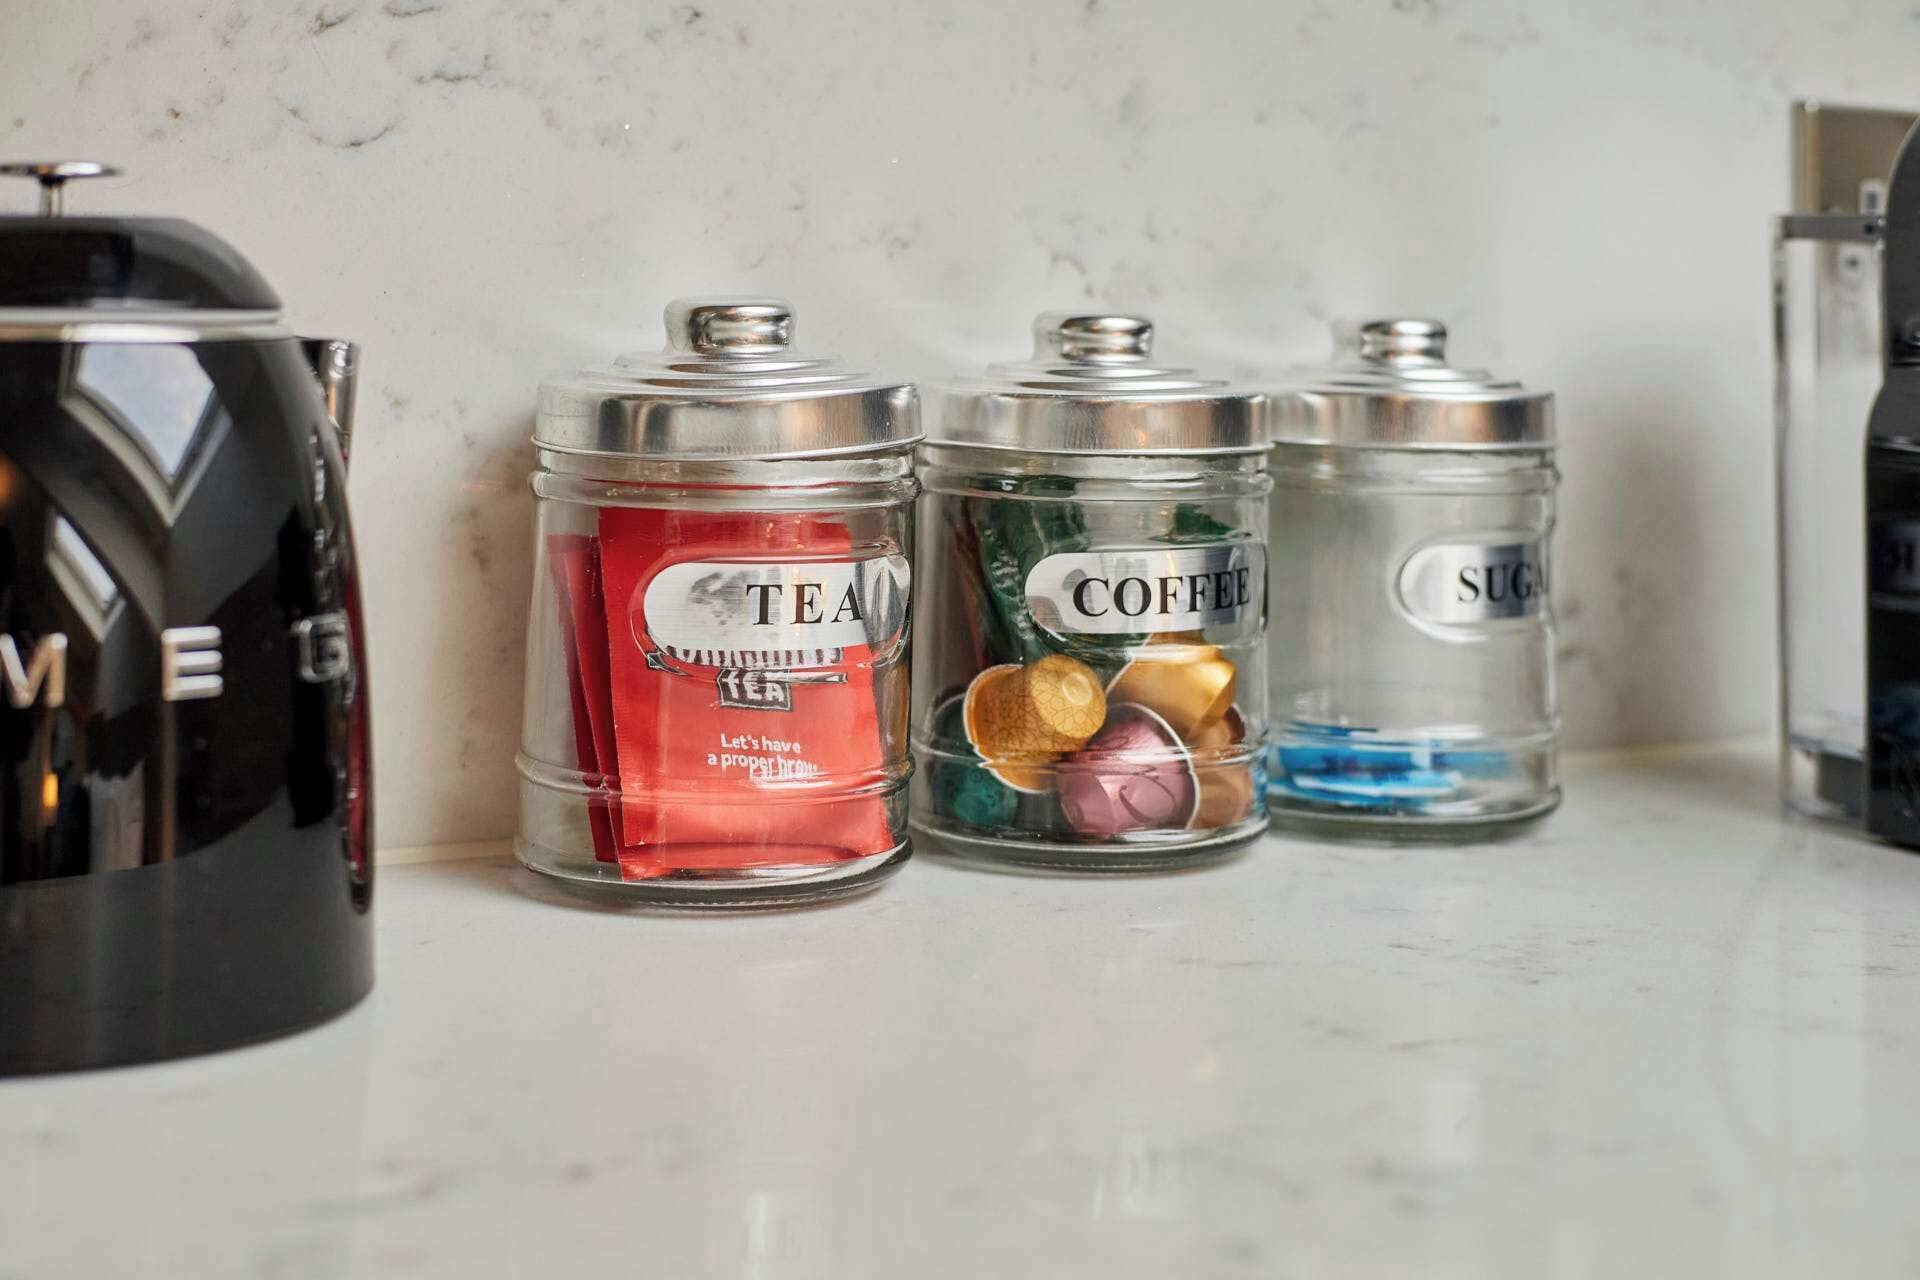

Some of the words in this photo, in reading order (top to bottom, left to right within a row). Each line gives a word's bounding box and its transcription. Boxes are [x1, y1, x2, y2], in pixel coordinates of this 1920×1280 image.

[746, 581, 864, 626] TEA
[1072, 566, 1250, 618] COFFEE
[721, 671, 785, 702] TEA
[720, 733, 759, 750] Let's
[761, 735, 801, 754] have
[707, 753, 718, 766] a
[720, 753, 775, 777] proper
